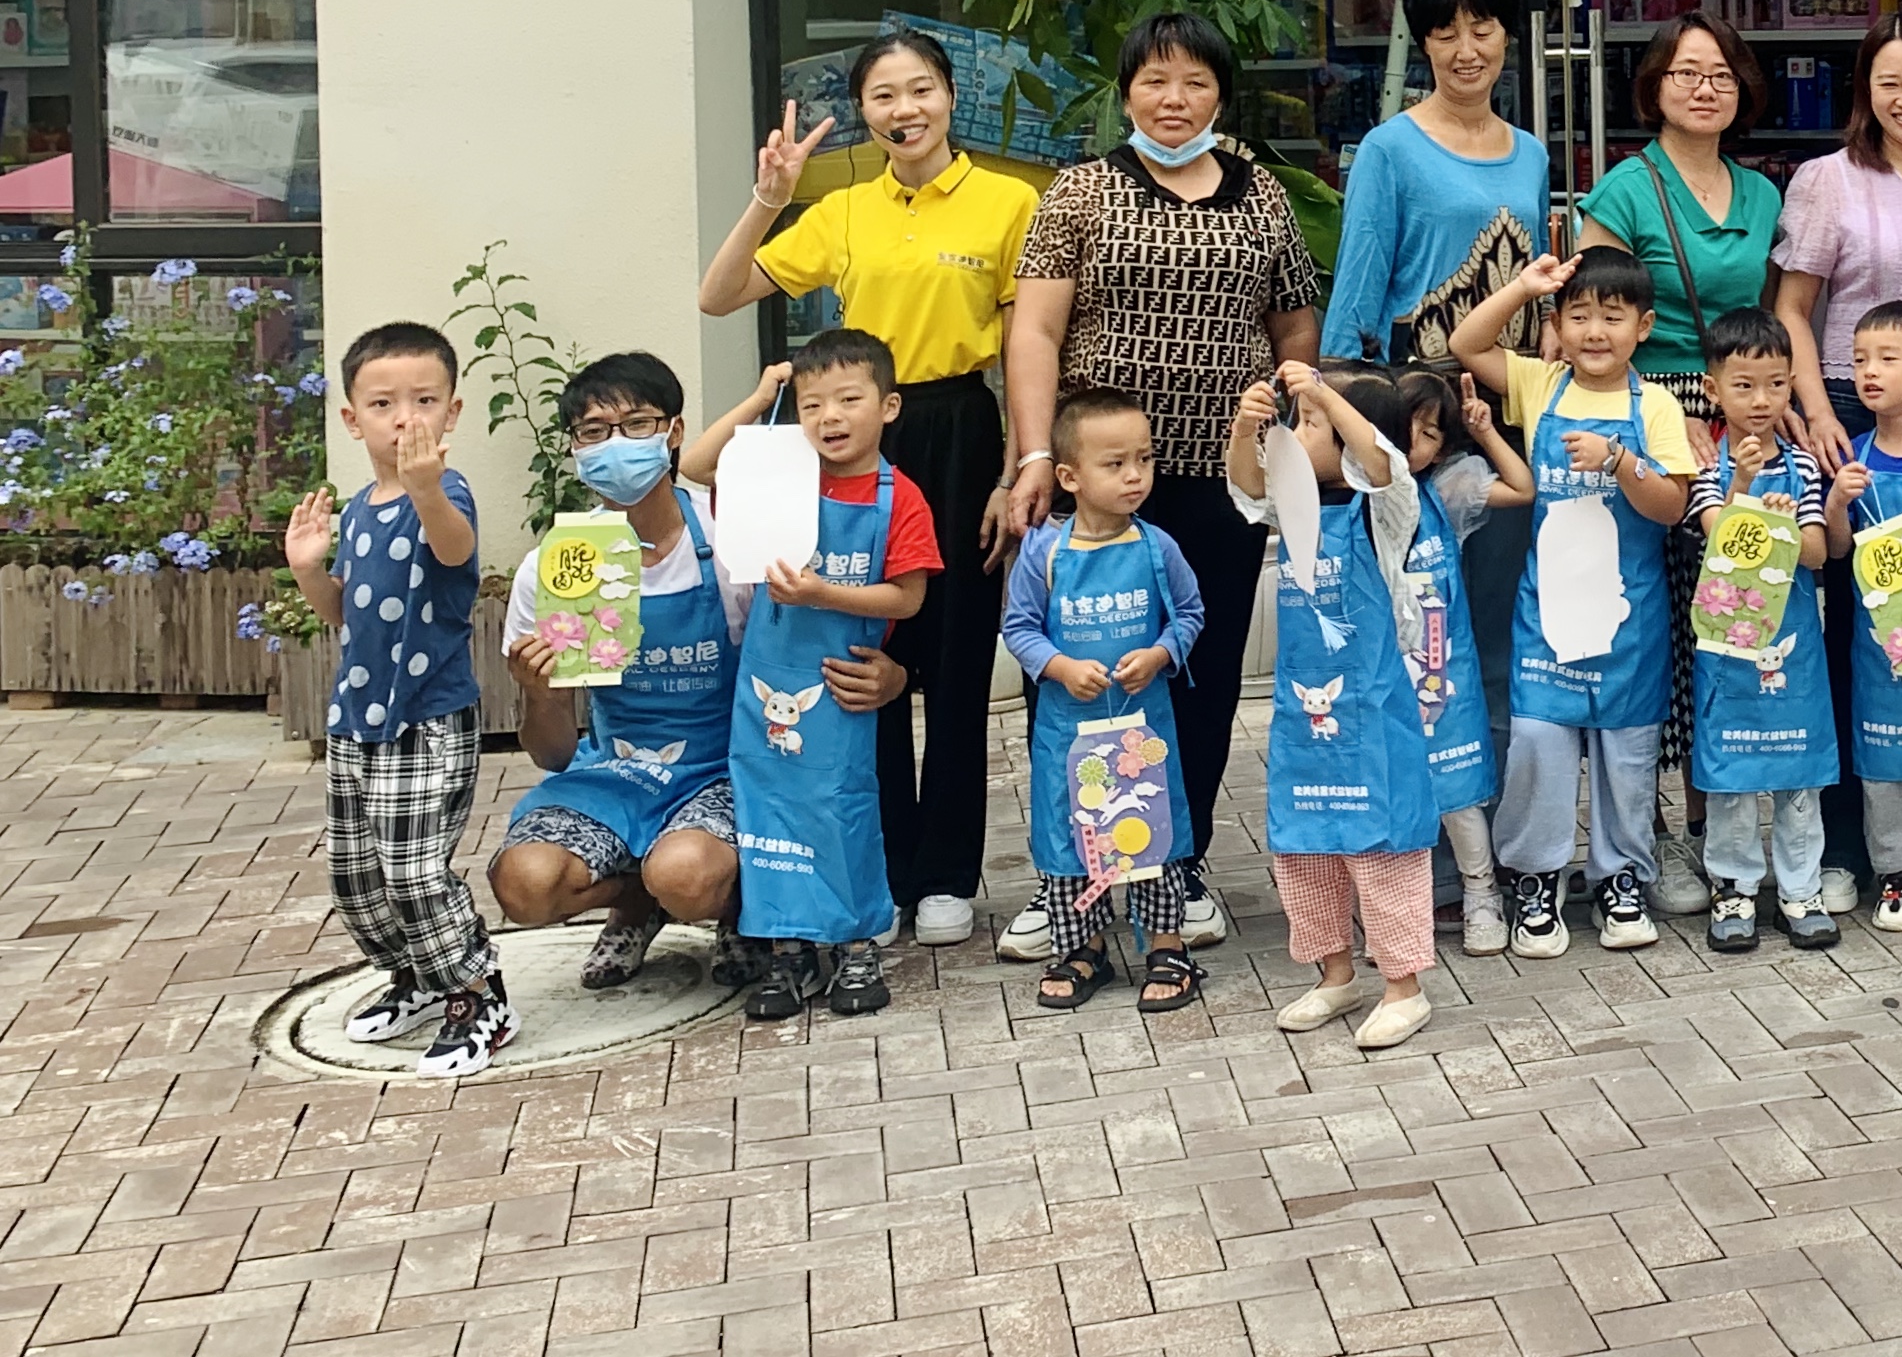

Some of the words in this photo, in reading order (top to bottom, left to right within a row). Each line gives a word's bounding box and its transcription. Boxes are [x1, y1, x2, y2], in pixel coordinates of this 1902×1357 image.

[1060, 588, 1149, 617] 皇家迪智尼
